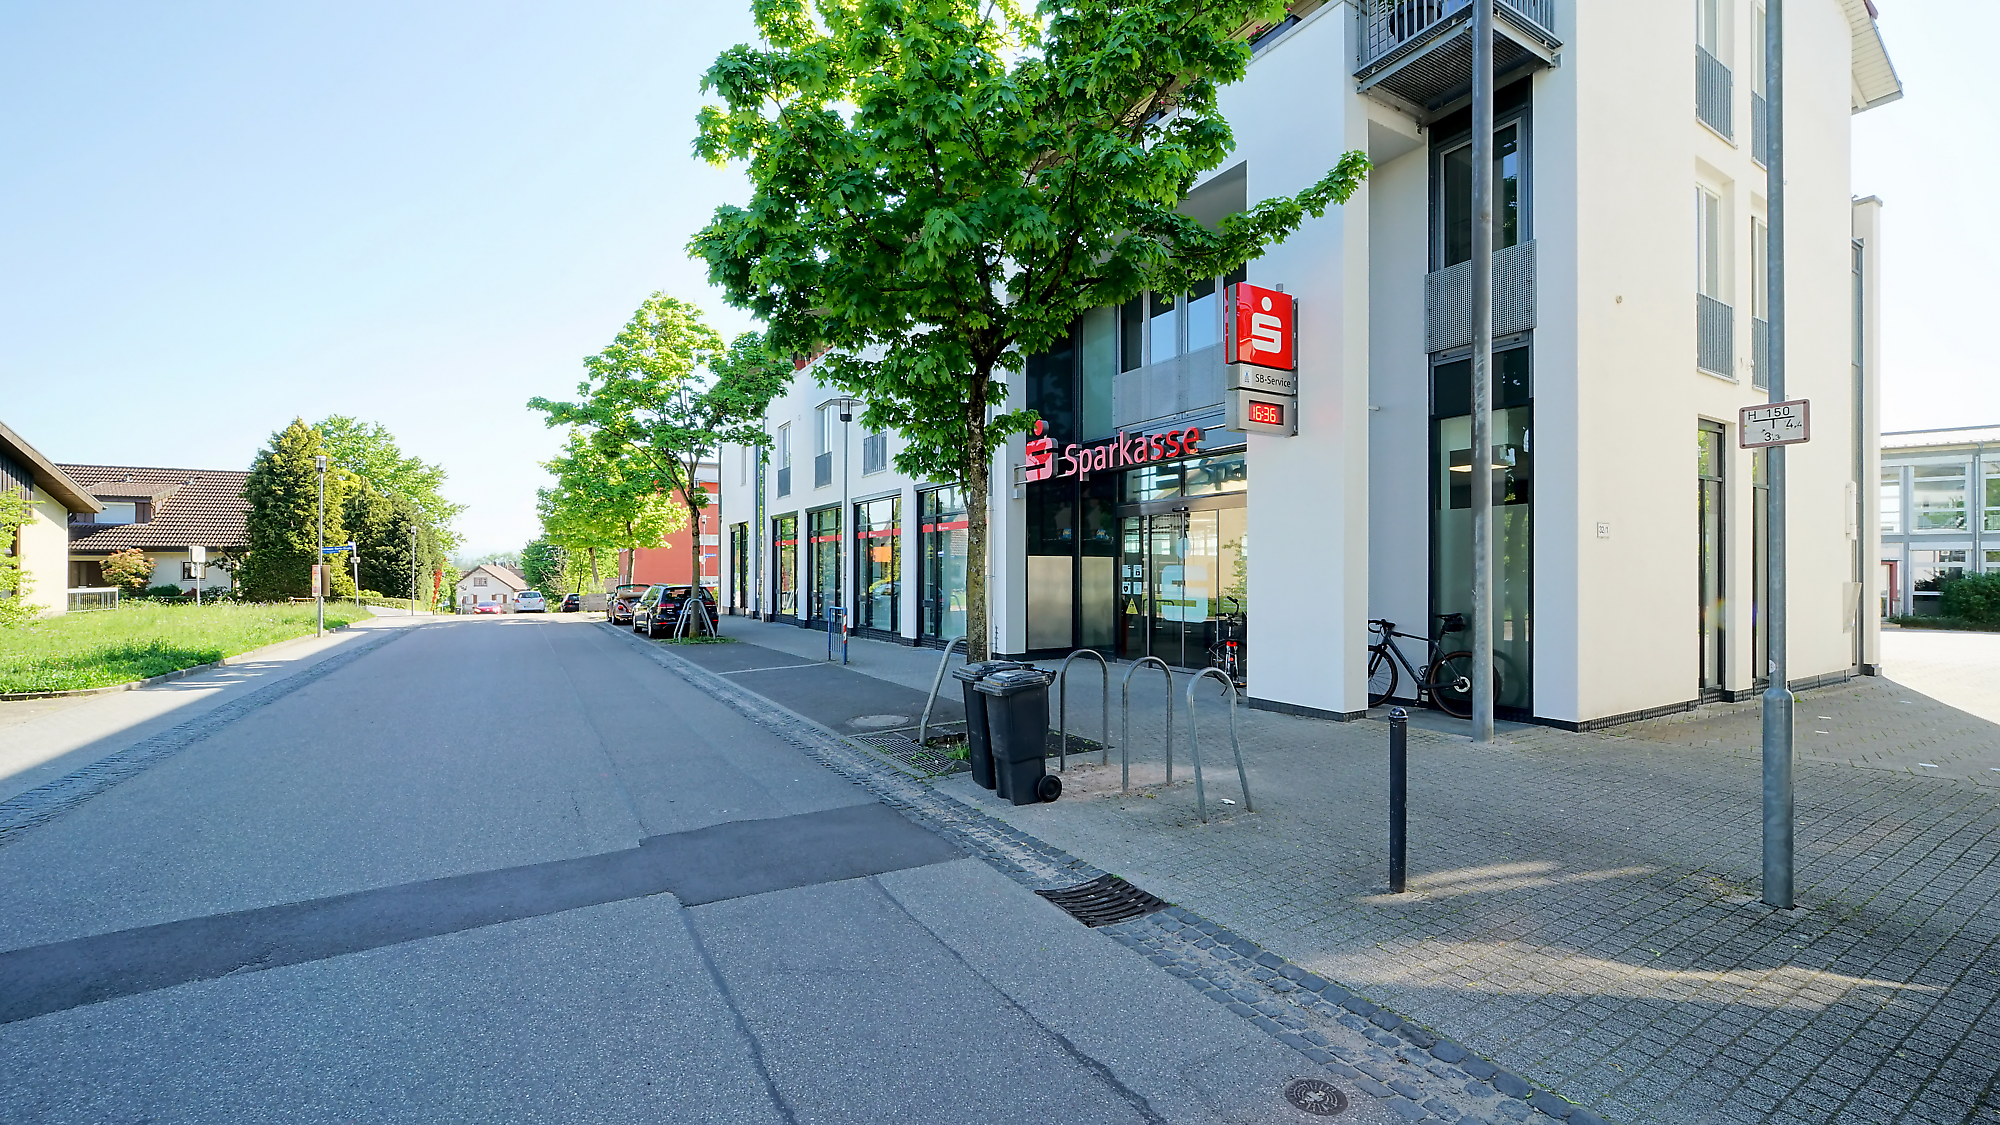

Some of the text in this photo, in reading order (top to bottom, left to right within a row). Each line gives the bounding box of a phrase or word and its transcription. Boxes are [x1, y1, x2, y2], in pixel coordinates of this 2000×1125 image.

[1255, 373, 1291, 388] SB-Service
[1252, 404, 1277, 423] 16:36
[1748, 406, 1790, 420] H 150
[1064, 426, 1200, 480] Sparkasse
